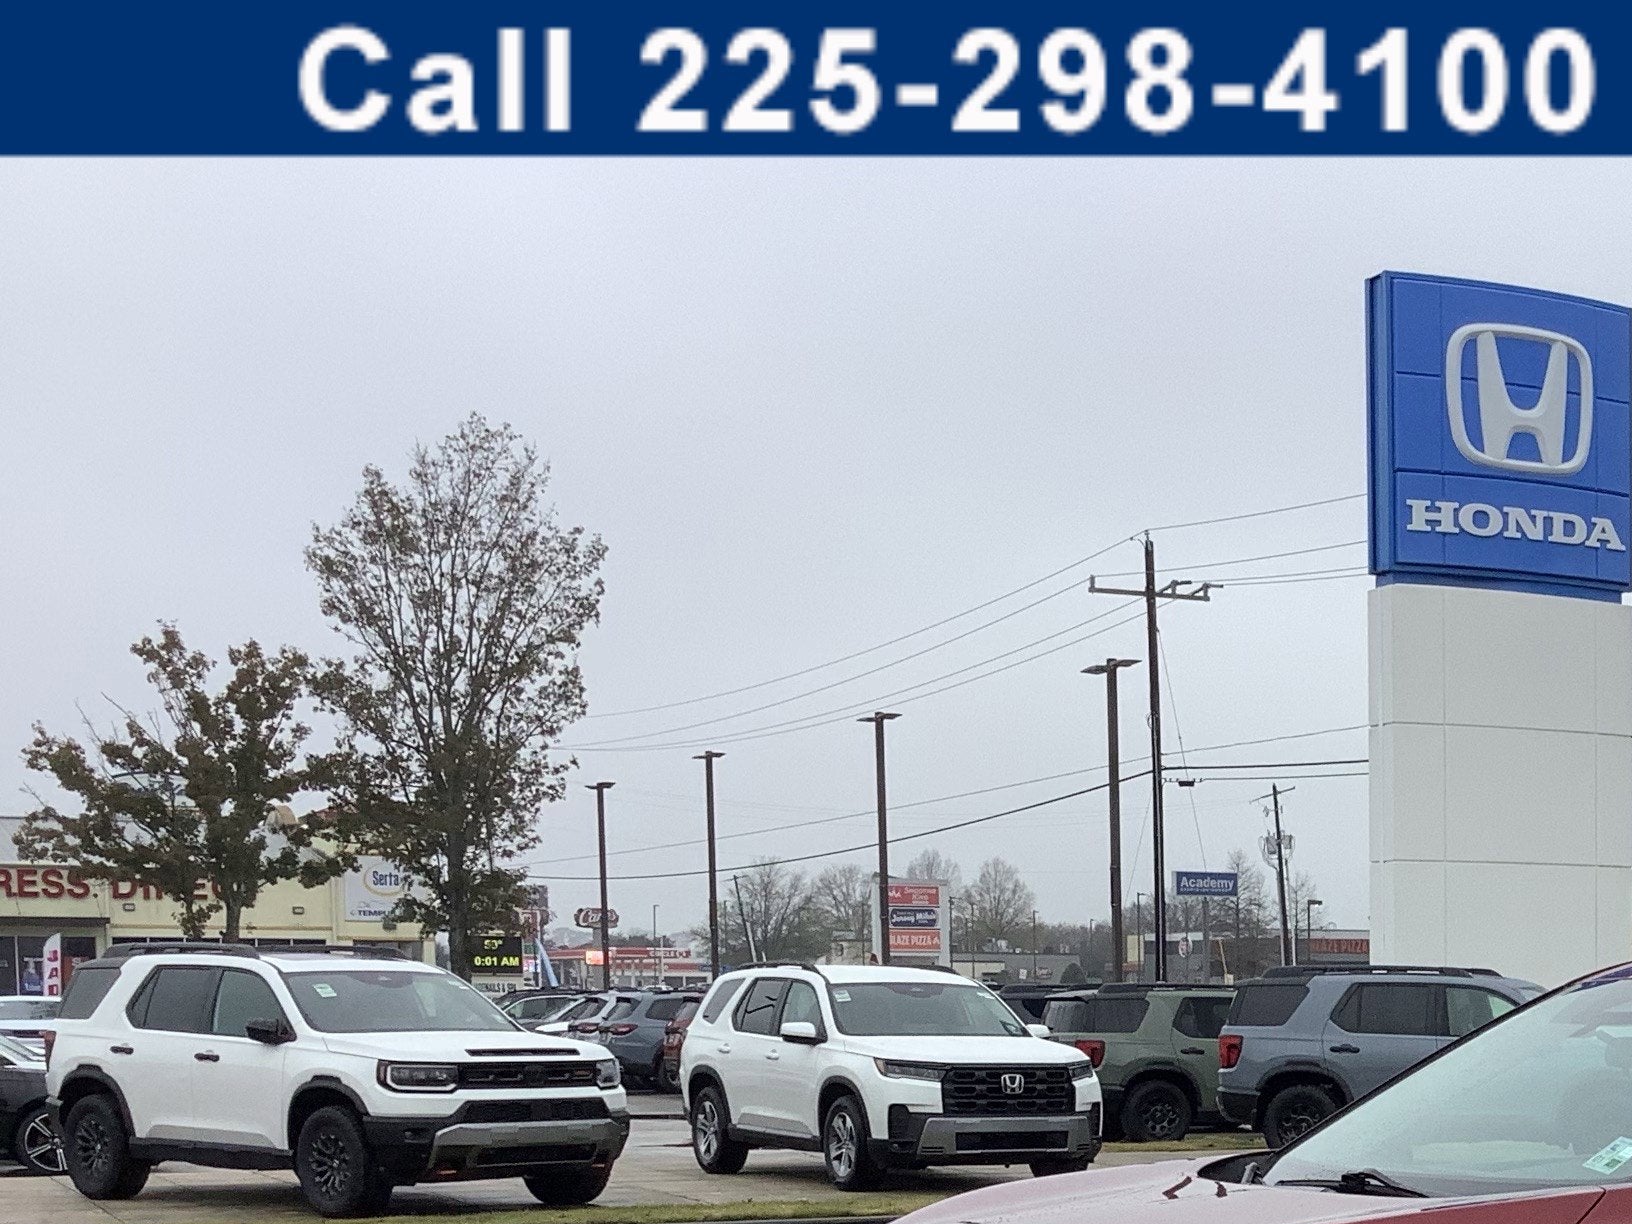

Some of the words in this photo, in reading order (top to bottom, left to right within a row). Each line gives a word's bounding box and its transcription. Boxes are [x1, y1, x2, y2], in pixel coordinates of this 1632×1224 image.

[1406, 499, 1627, 552] HONDA
[372, 870, 400, 886] Serta
[1180, 876, 1234, 891] Academy
[501, 956, 520, 967] AM
